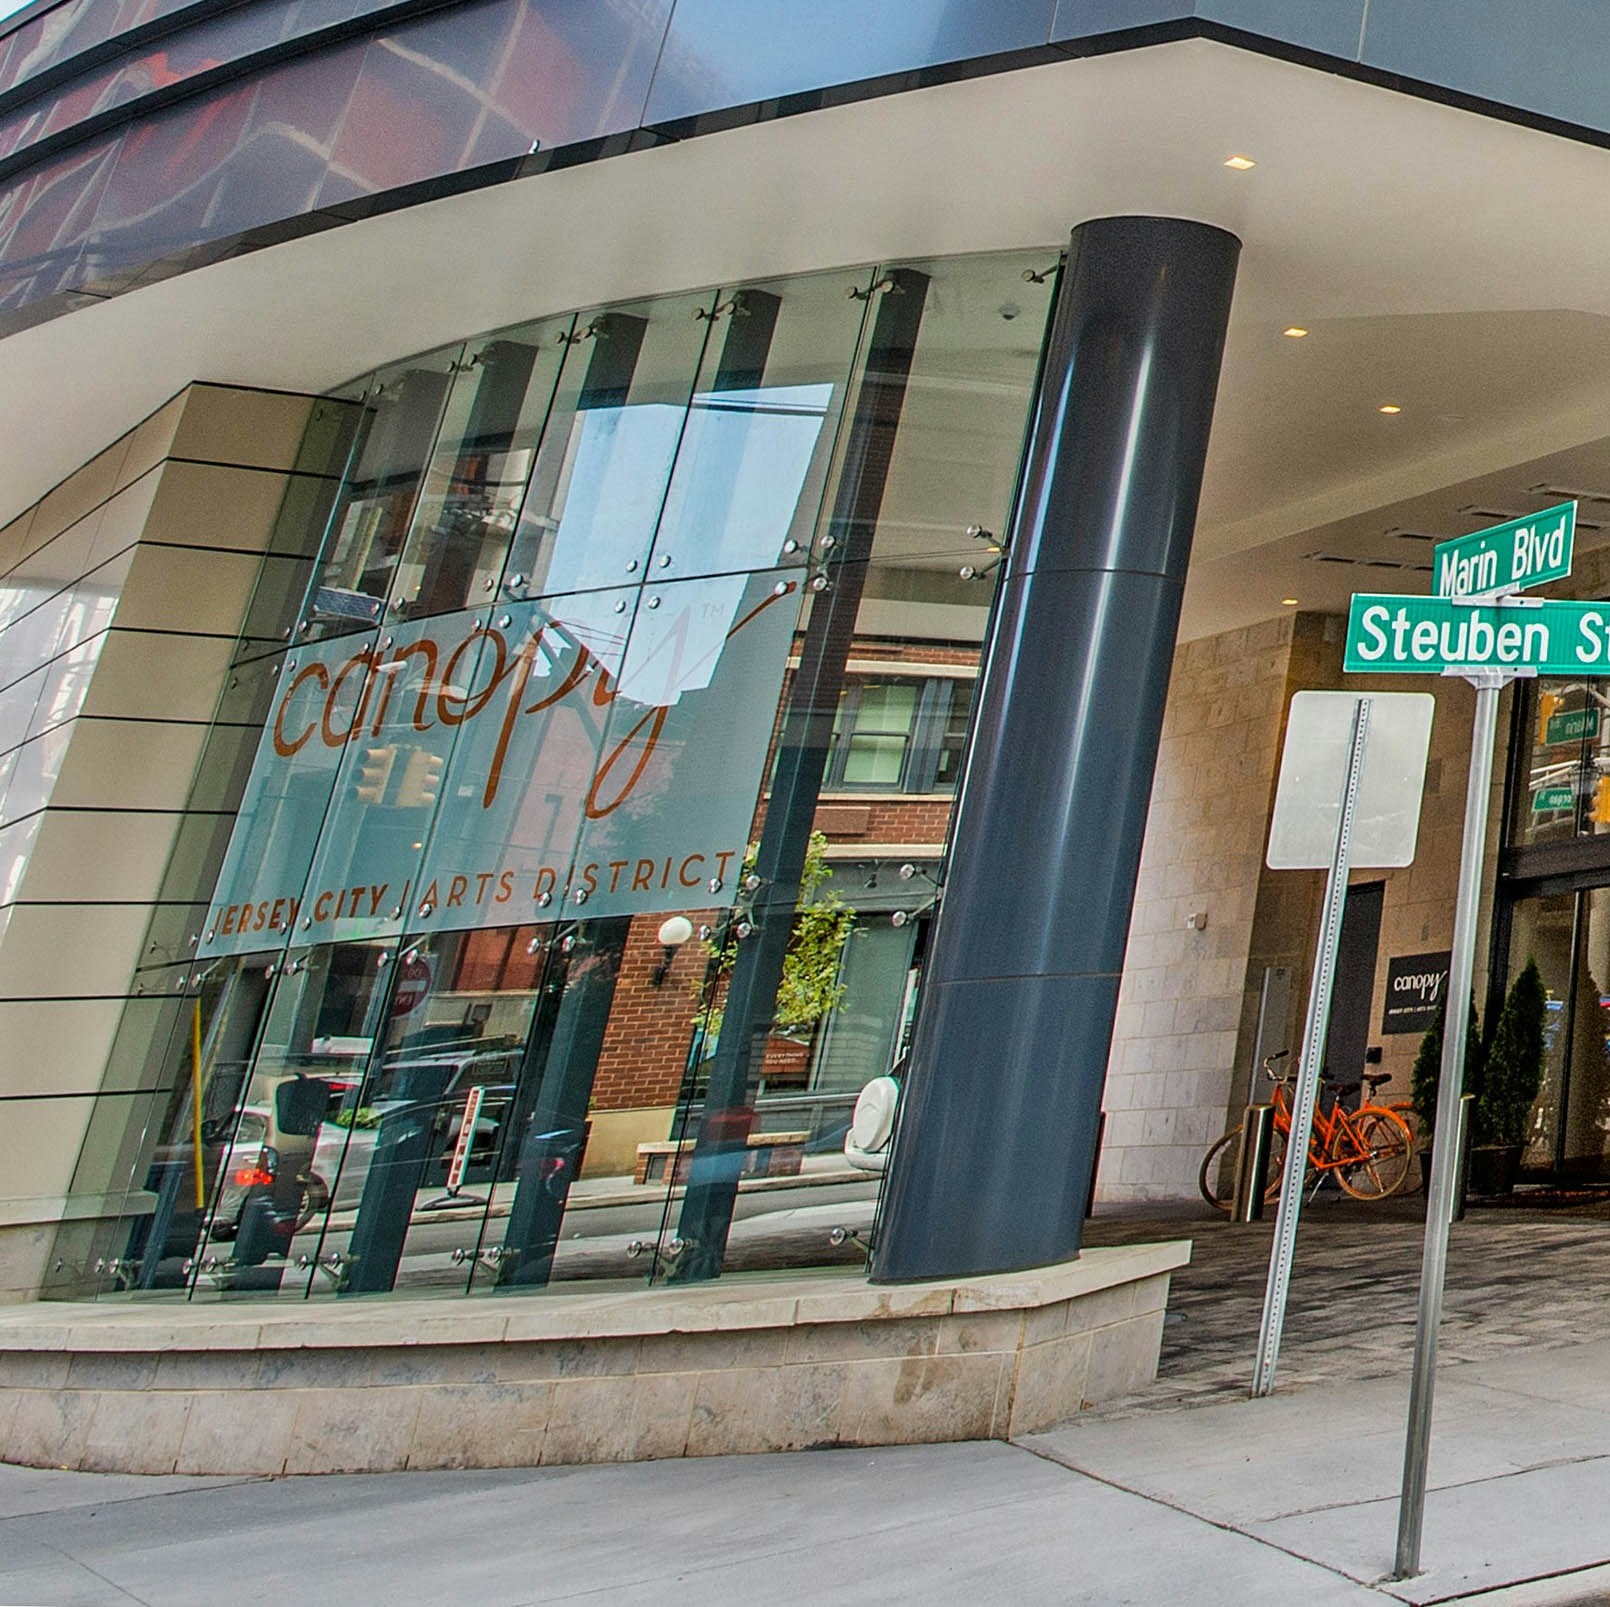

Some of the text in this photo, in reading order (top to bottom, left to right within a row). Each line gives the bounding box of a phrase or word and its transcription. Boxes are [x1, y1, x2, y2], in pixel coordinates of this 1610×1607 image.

[1438, 515, 1566, 598] Marin Blvd
[1356, 605, 1549, 662] Steuben
[273, 580, 797, 821] canopy
[212, 897, 301, 937] JERSEY
[313, 883, 390, 923] CITY
[420, 871, 515, 908] ARTS
[534, 850, 736, 900] DISTRICT
[1394, 970, 1448, 1002] canopy
